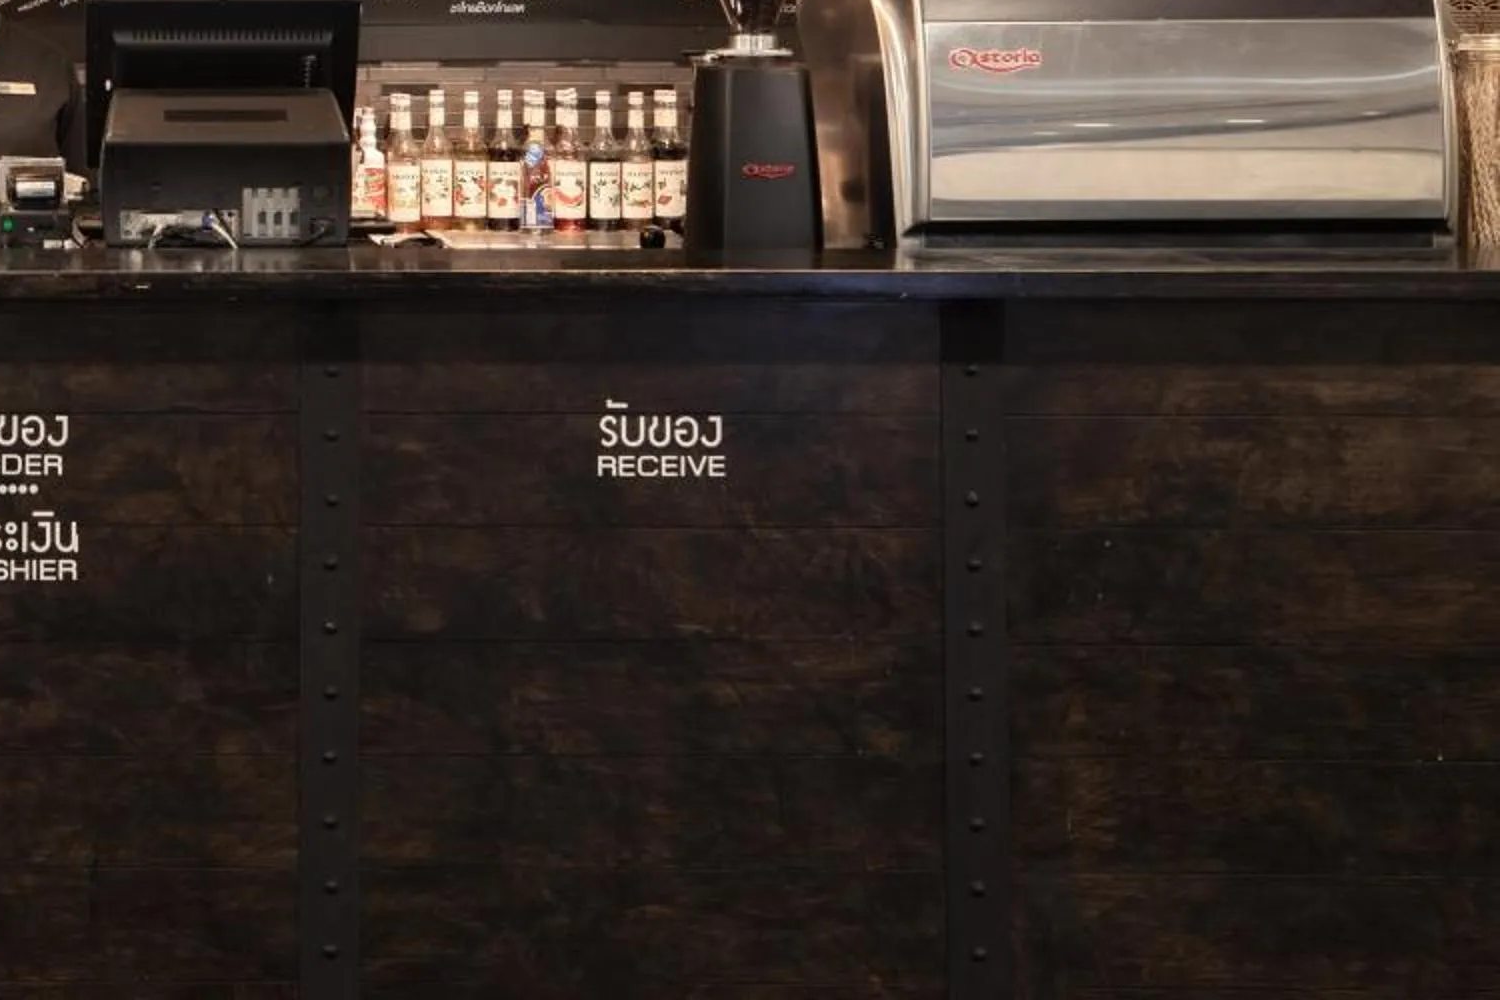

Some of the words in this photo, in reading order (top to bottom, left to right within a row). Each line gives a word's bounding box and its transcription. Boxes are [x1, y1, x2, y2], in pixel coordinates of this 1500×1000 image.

[600, 400, 722, 447] รับของ
[598, 455, 725, 476] RECEIVE
